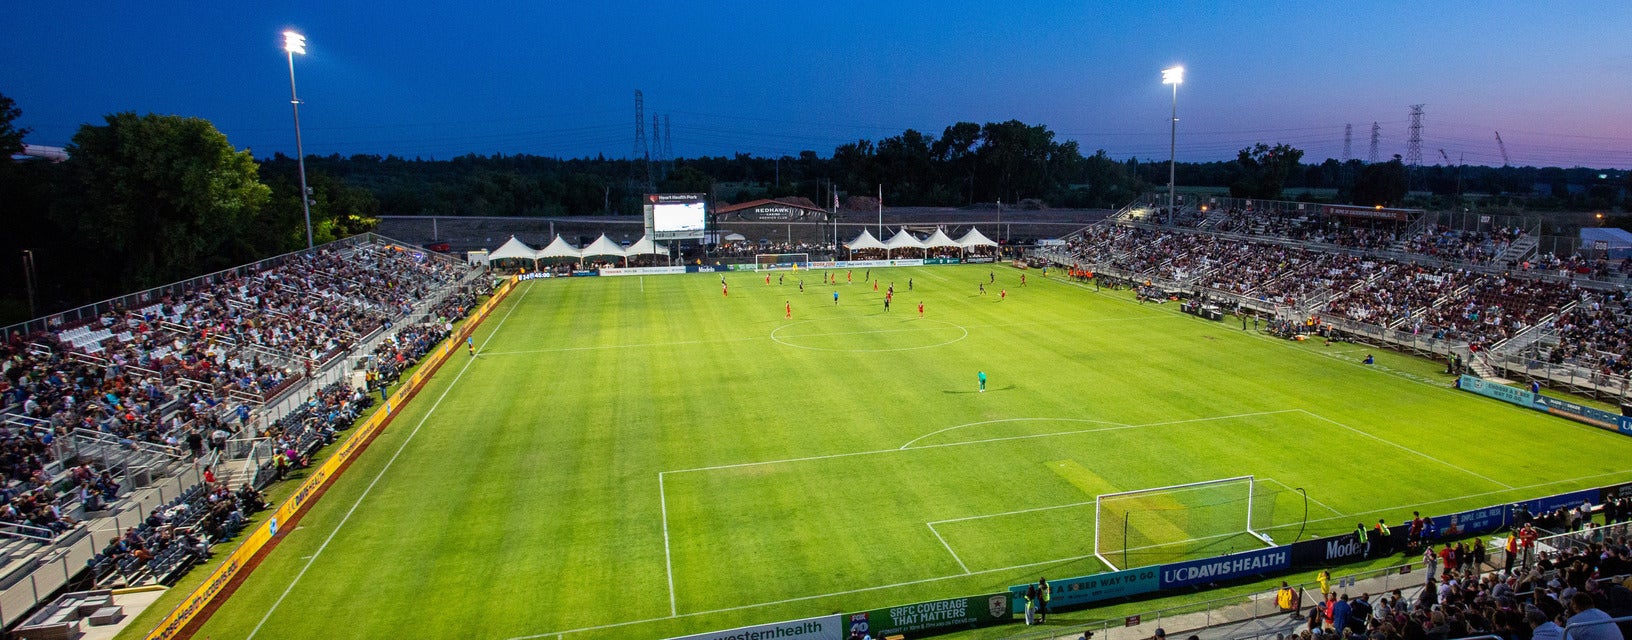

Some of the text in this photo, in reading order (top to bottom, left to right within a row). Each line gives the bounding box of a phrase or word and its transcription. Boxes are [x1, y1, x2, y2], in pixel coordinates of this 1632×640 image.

[1057, 585, 1064, 593] A
[1100, 576, 1121, 586] WAY
[890, 599, 968, 618] SRFC COVERAGE
[893, 608, 966, 626] THAT MATTERS
